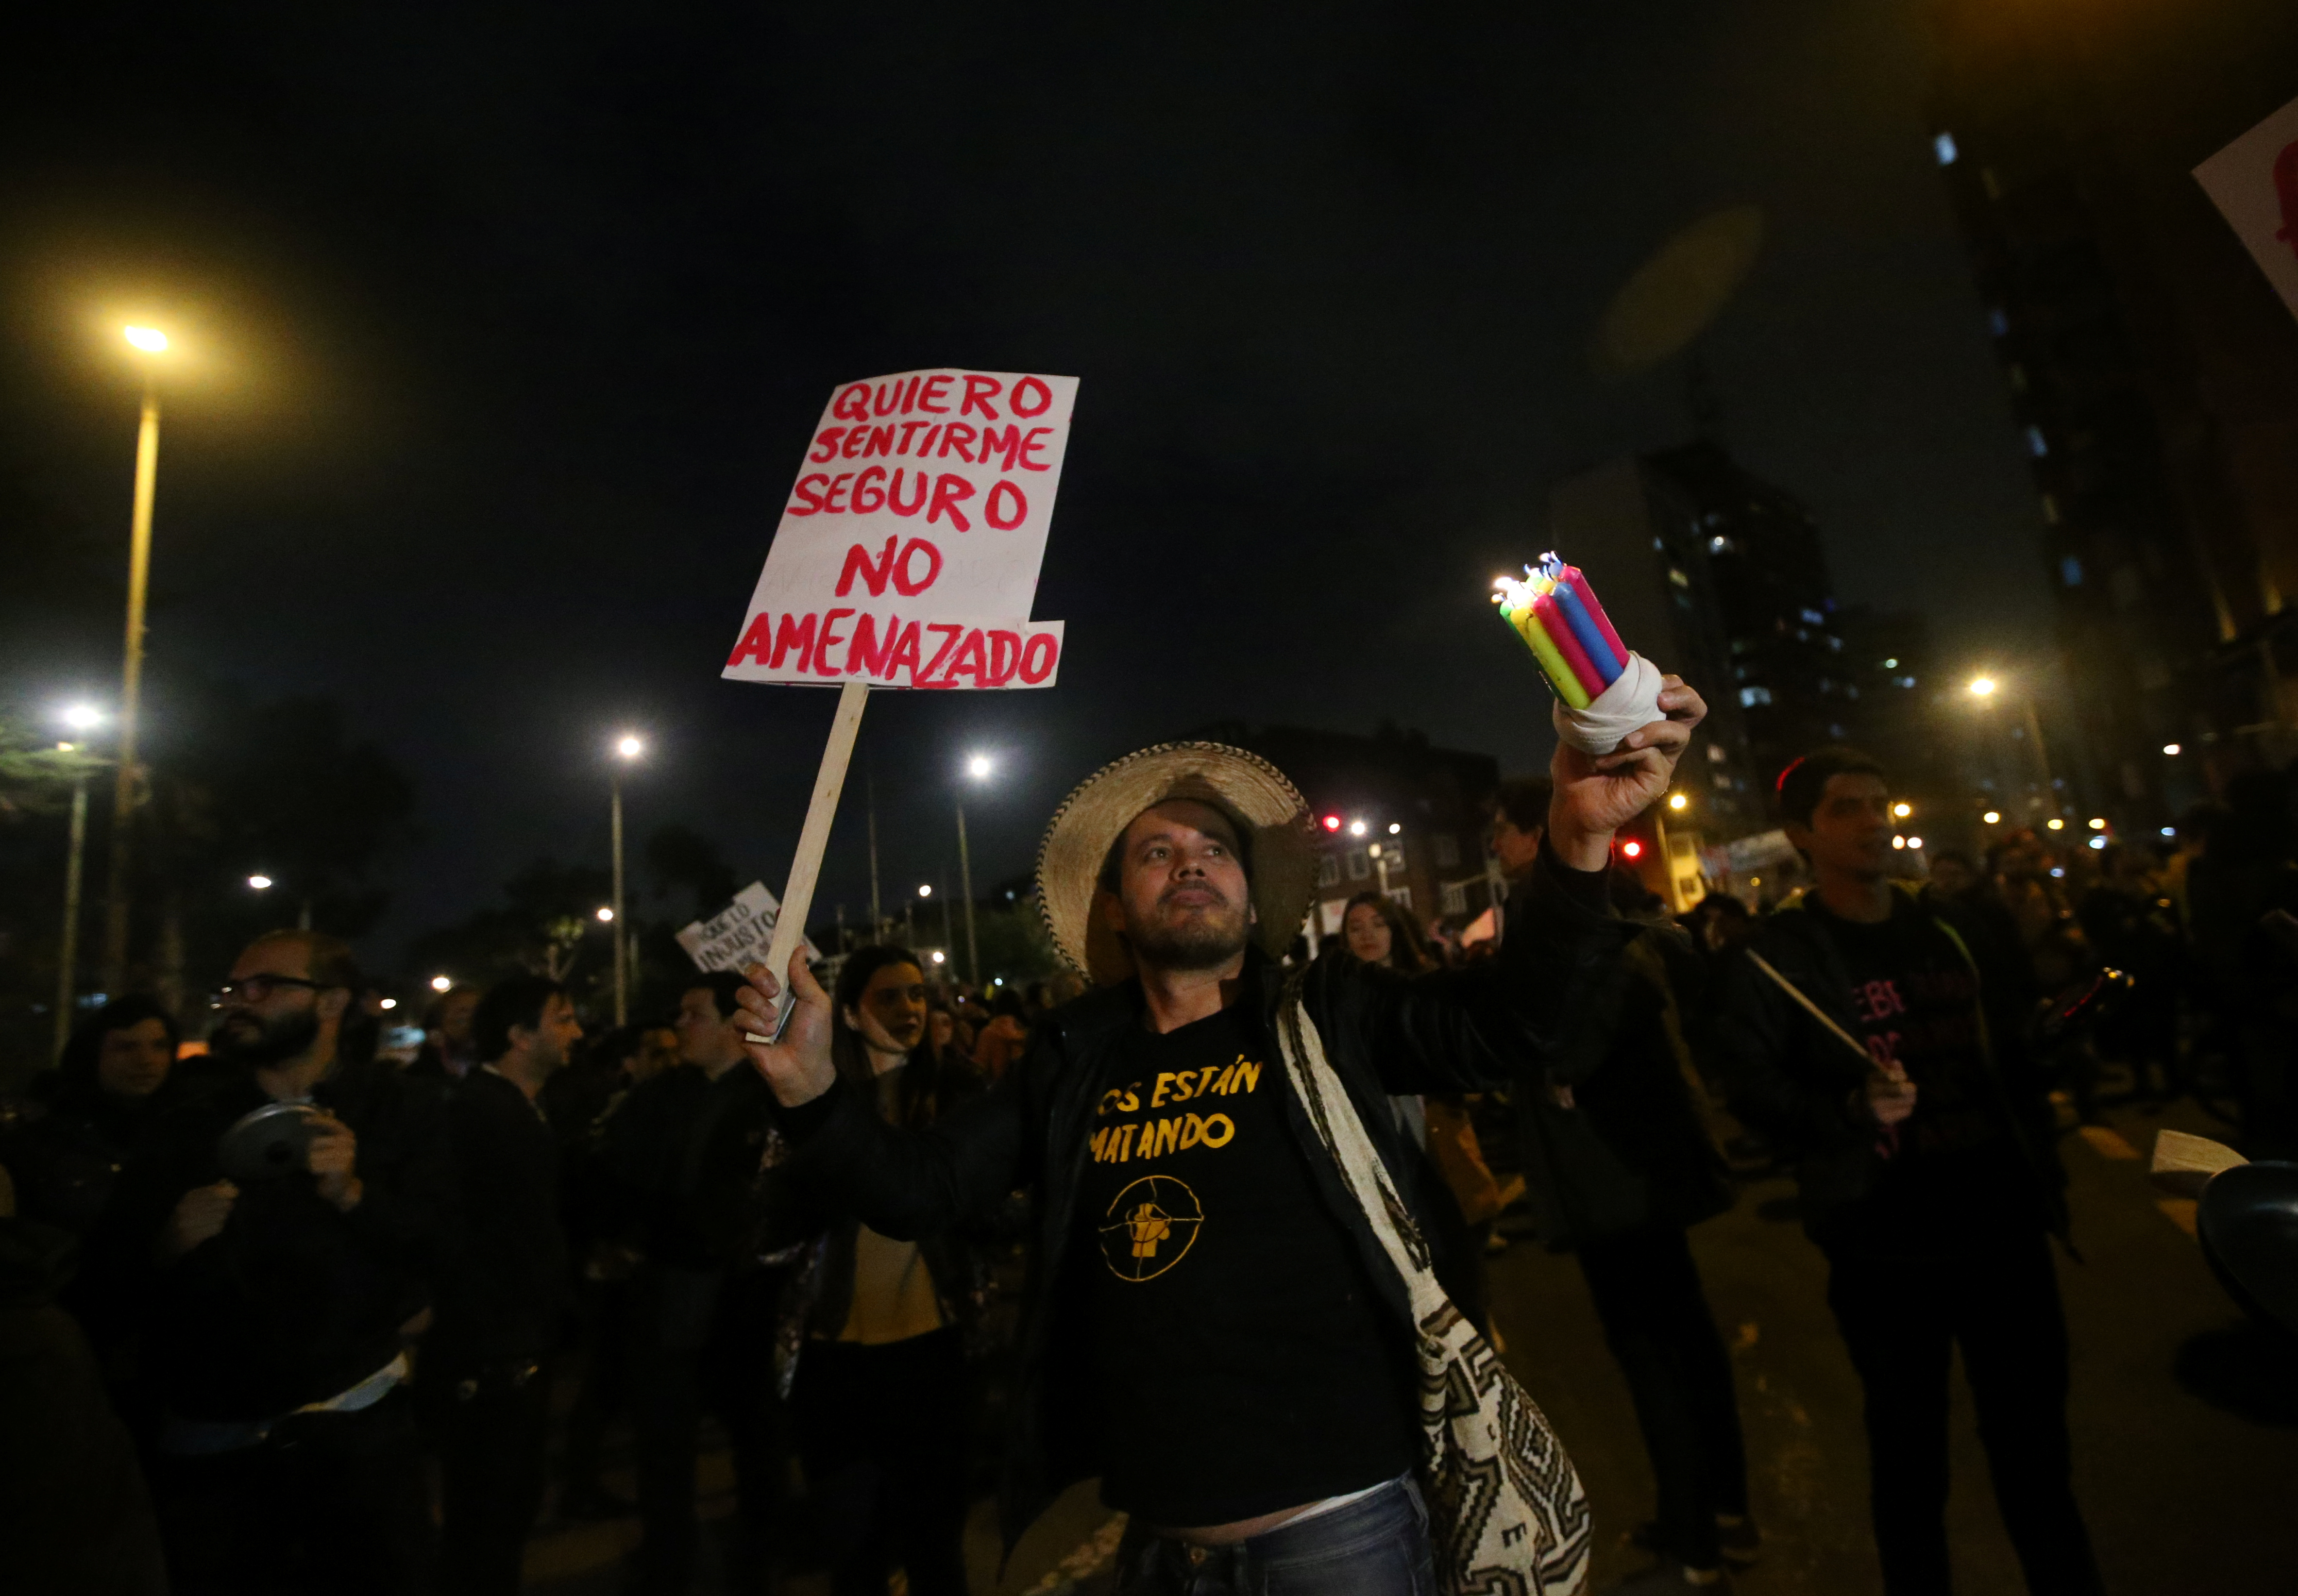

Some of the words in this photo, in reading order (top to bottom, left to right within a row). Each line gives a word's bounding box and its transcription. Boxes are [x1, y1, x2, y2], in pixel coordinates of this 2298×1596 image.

[832, 375, 1052, 422] QUIERO
[810, 421, 1054, 472] SENTIRME
[787, 465, 1028, 533] SEGURO
[835, 535, 943, 597] NO
[726, 608, 1059, 688] AMENAZADO
[698, 910, 777, 971] INJUSTO
[1096, 1081, 1142, 1116] OS
[1150, 1054, 1263, 1108] ESTÁN
[1089, 1112, 1235, 1163] MATANDO
